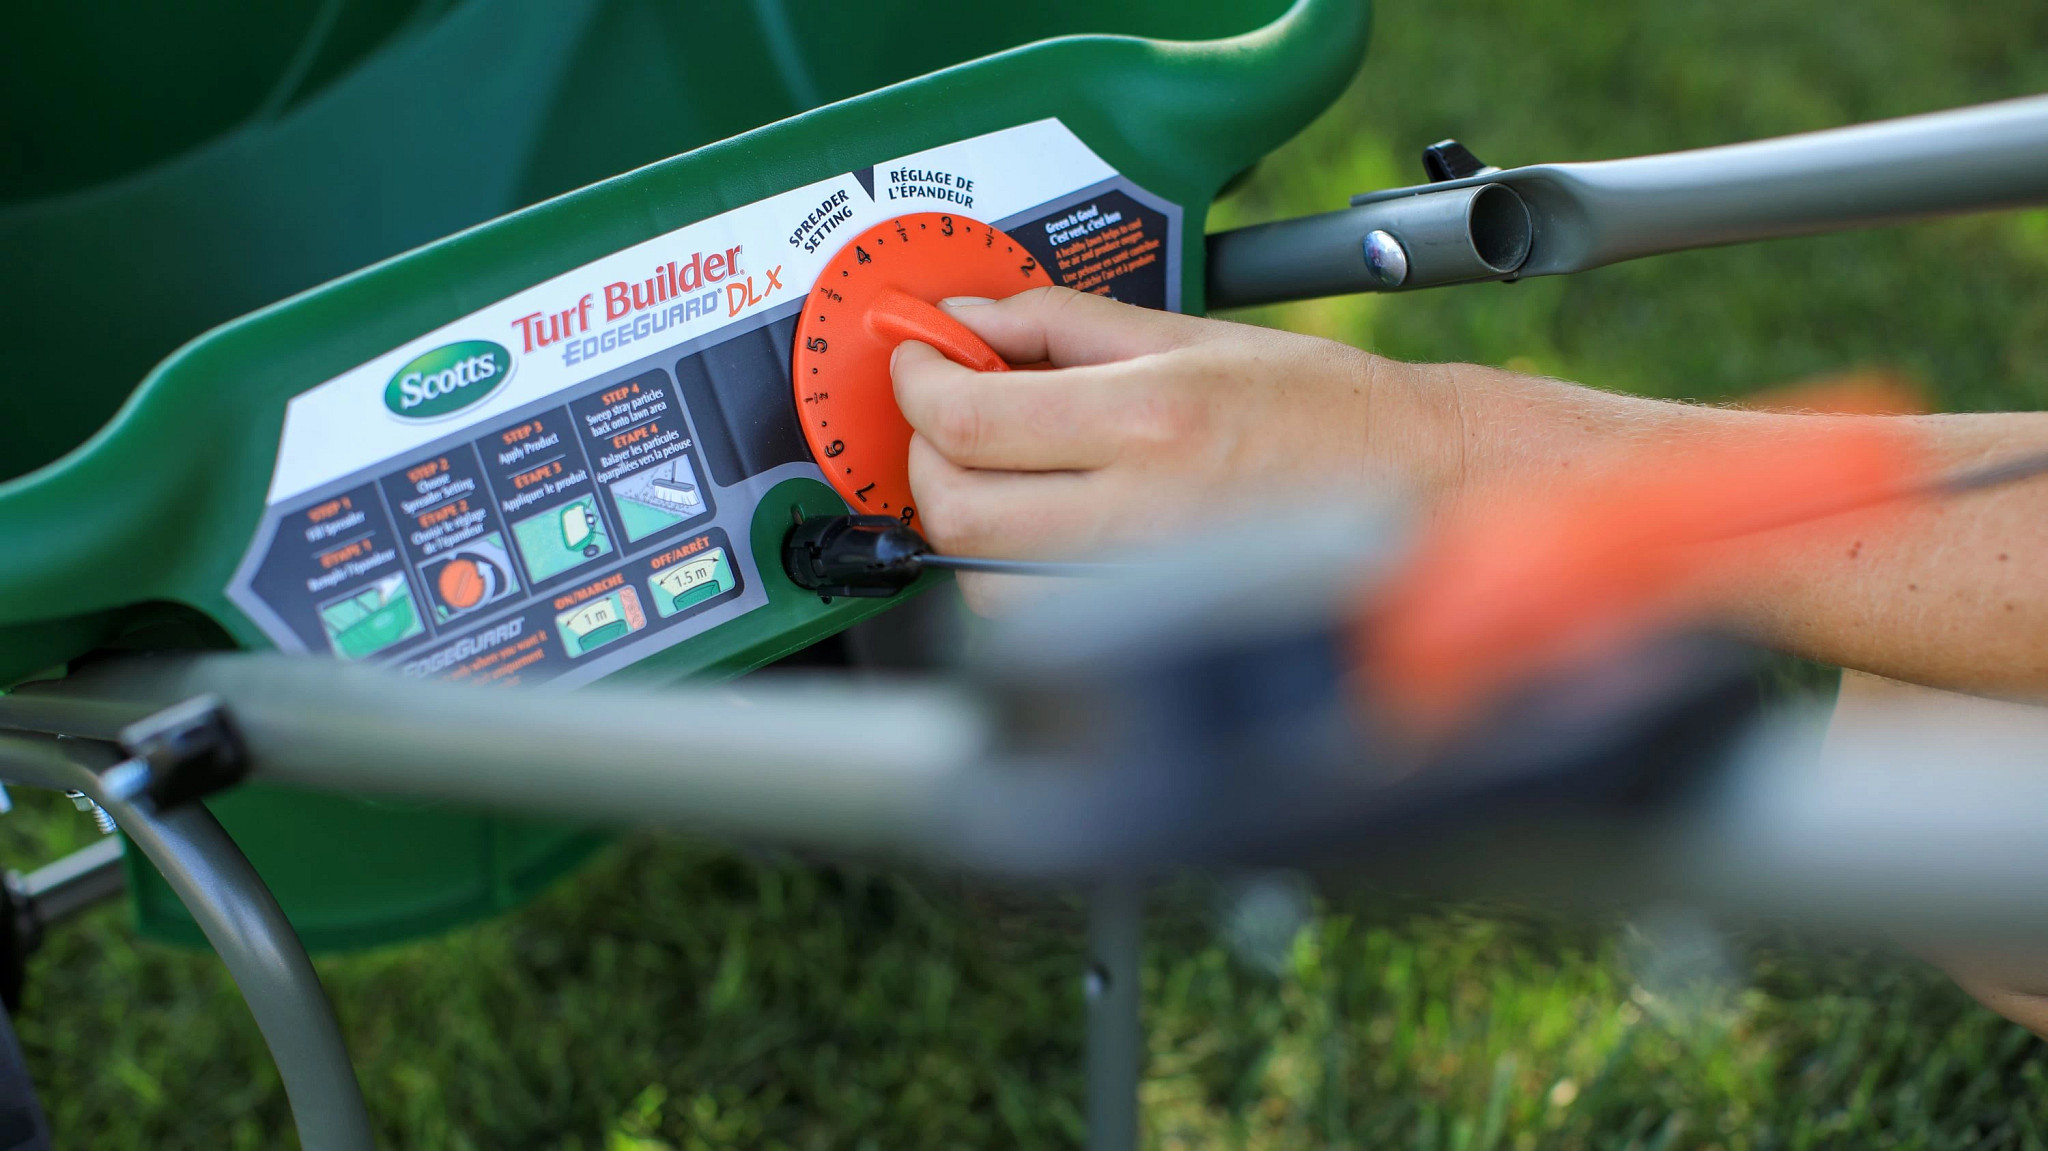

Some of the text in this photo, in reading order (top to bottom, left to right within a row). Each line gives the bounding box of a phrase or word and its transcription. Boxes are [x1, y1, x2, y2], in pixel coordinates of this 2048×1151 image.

[891, 167, 974, 192] RÉGLAGE DE
[889, 183, 973, 209] L'ÉPANDEUR
[789, 190, 850, 248] SPREADER
[805, 206, 853, 254] SETTING
[941, 216, 954, 236] 3
[1045, 219, 1070, 233] Green
[1077, 205, 1098, 221] Good
[1049, 231, 1070, 246] C'est
[1104, 211, 1122, 224] bon
[856, 246, 871, 264] 4
[1021, 257, 1036, 278] 2
[511, 245, 743, 355] Turf Builder
[726, 265, 782, 317] DLX
[807, 337, 828, 353] 5
[400, 352, 497, 410] Scotts
[602, 383, 640, 406] STEP 4
[586, 389, 663, 426] Sweep stray particles
[590, 401, 667, 437] back onto lawn area
[502, 421, 543, 444] STEP 3
[650, 424, 658, 434] 4
[499, 433, 559, 465] Apply Product
[597, 439, 692, 483] éparpillées vers la pelouse
[601, 430, 679, 467] Balayer les particules
[825, 440, 844, 458] 6
[407, 458, 450, 483] STEP 2
[553, 461, 562, 474] 3
[416, 473, 450, 493] Choose
[502, 469, 588, 512] Appliquer le produit
[855, 482, 874, 502] 7
[401, 478, 475, 514] Spreader Setting
[459, 499, 469, 513] 2
[901, 506, 914, 526] 8
[411, 524, 443, 545] Choisir
[443, 521, 454, 532] le
[423, 539, 436, 555] de
[651, 536, 710, 569] OFF/ARRÊT
[675, 567, 707, 588] 1.5 m
[554, 573, 625, 610] ON/MARCHE
[585, 609, 607, 625] 1 m
